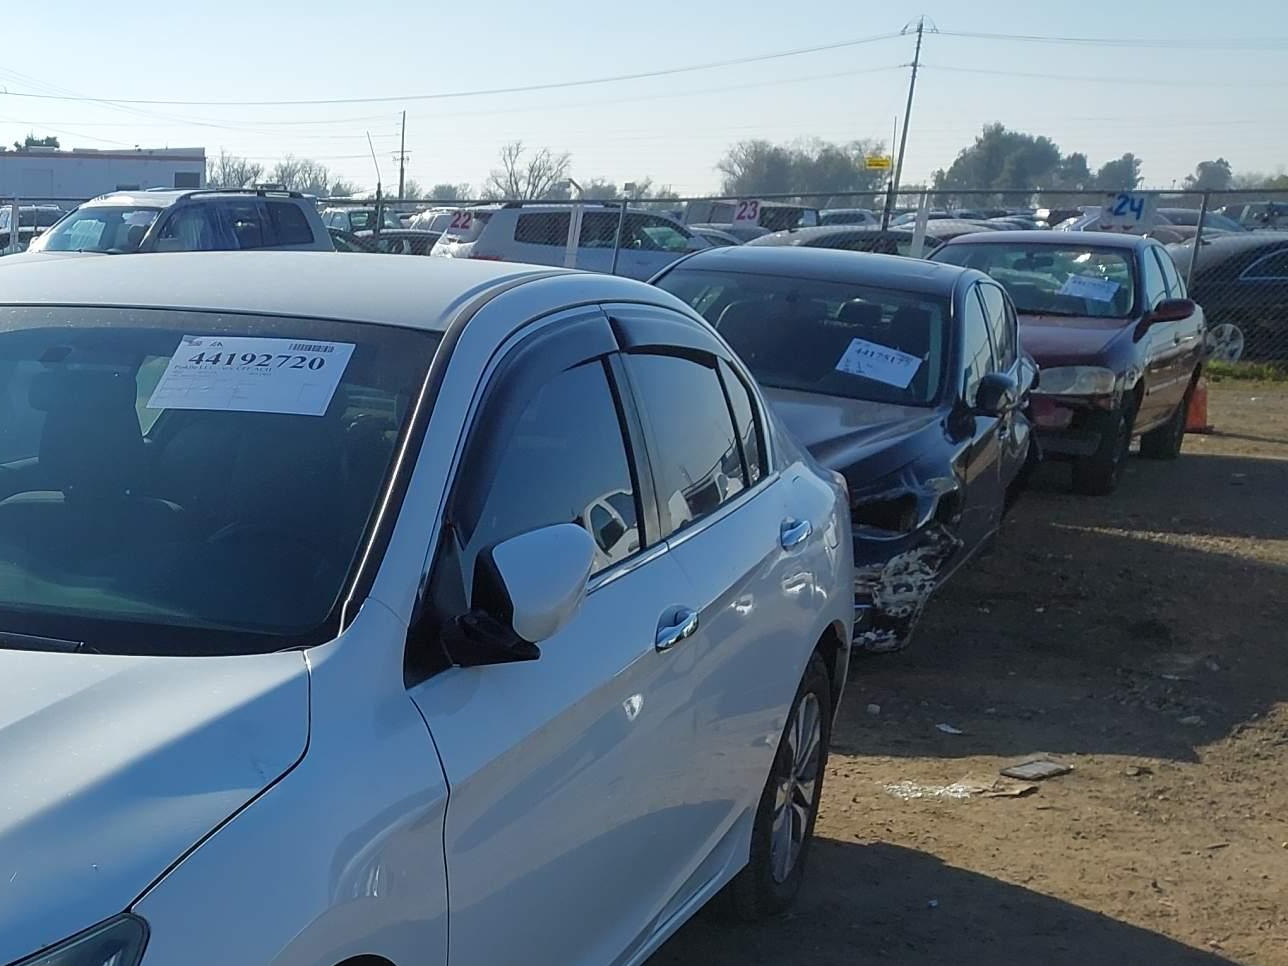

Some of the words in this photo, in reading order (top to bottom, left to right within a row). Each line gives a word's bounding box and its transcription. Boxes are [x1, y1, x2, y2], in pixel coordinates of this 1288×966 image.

[735, 200, 758, 220] 23
[1113, 192, 1145, 221] 24
[450, 210, 472, 229] 22
[187, 351, 325, 371] 44192720
